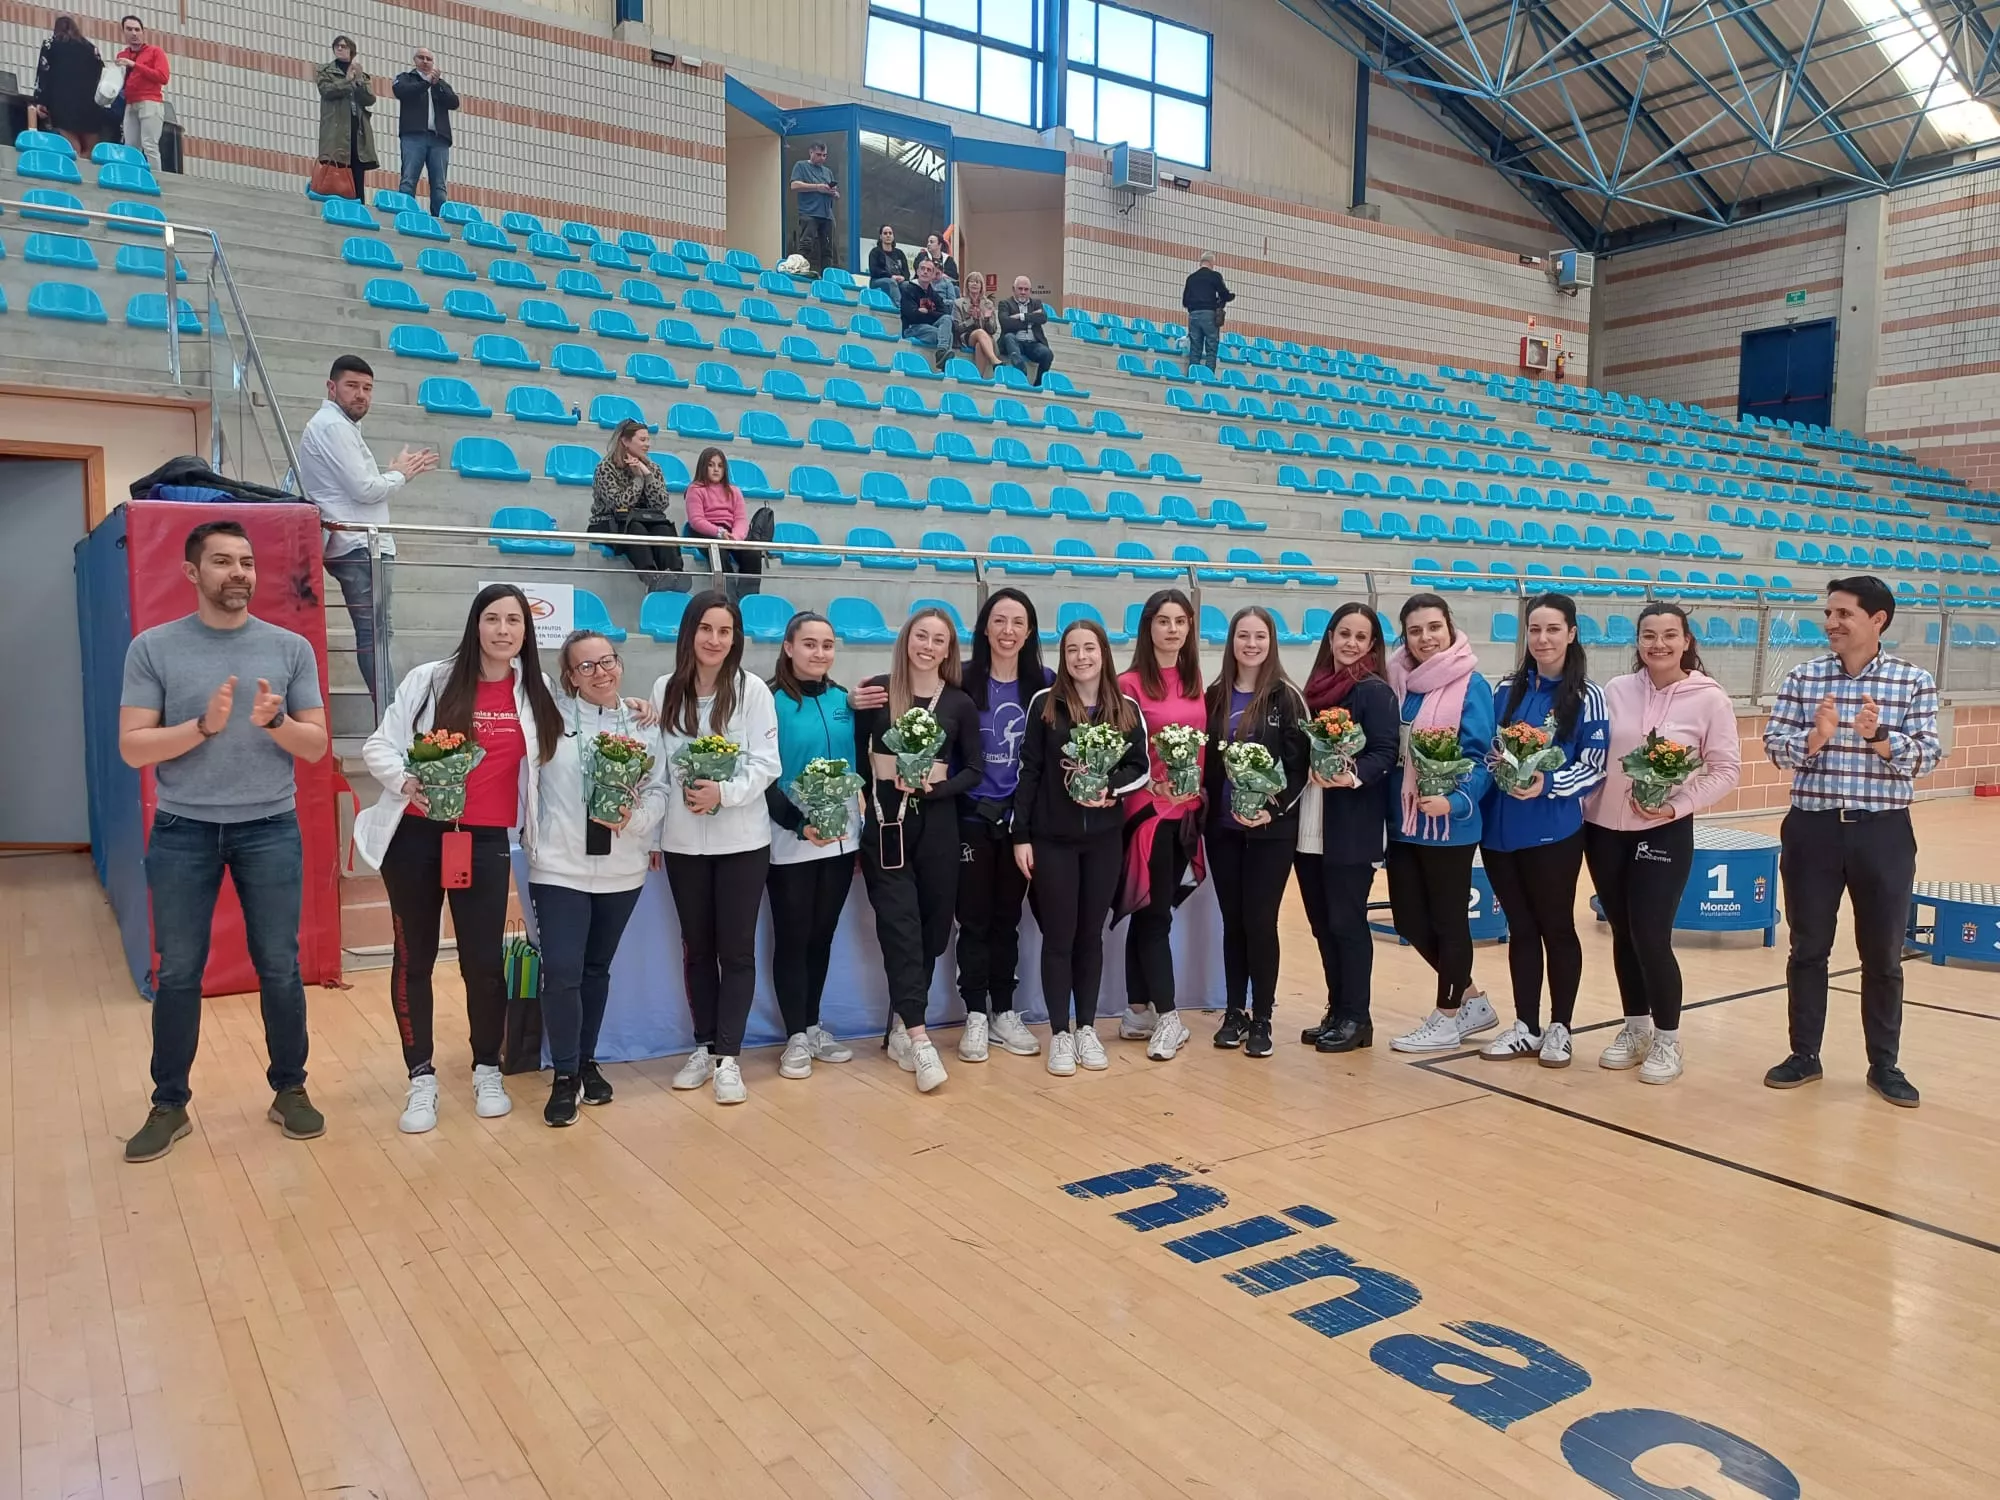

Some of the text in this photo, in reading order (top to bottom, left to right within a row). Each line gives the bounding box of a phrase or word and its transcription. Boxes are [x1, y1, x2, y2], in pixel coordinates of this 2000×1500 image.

[1707, 864, 1734, 898] 1
[1468, 887, 1480, 918] 2
[1700, 901, 1740, 911] Monzón
